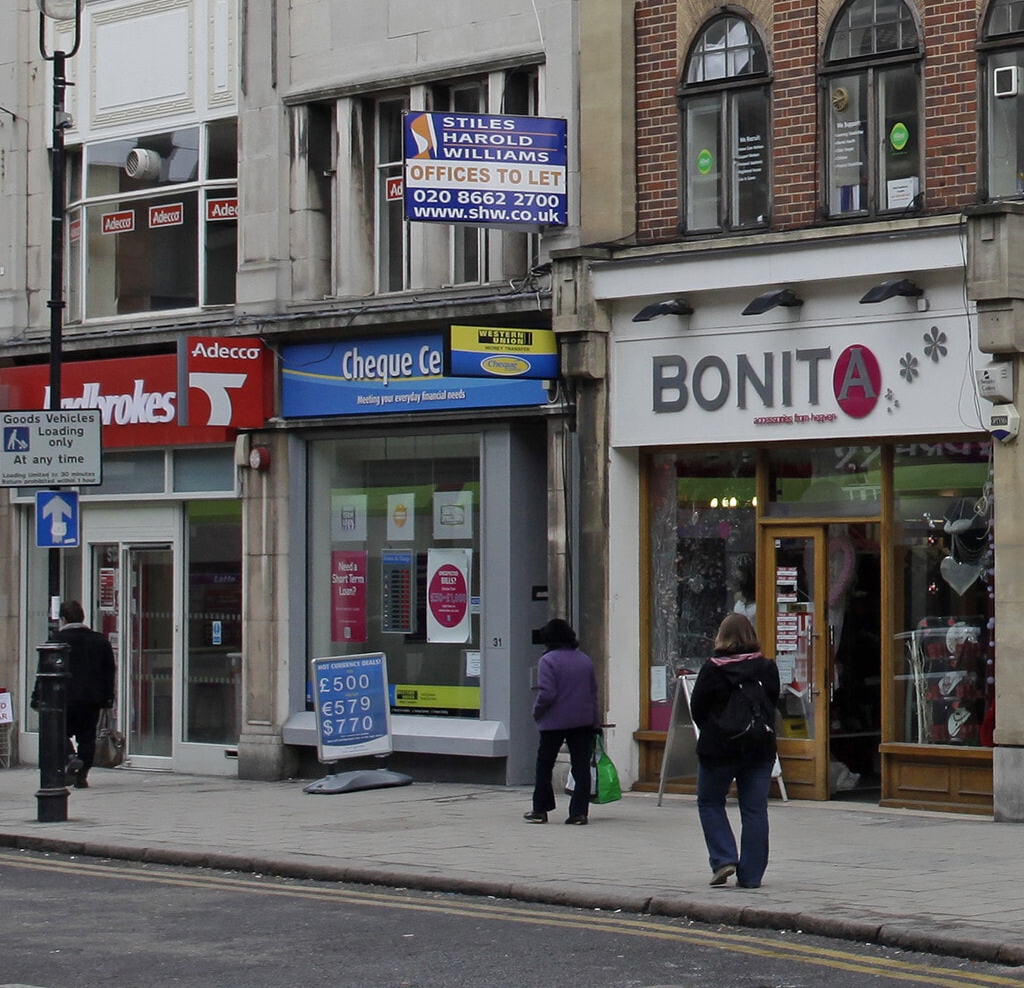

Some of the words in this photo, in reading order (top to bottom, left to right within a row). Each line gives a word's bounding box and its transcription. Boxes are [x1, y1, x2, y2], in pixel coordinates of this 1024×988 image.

[443, 117, 515, 130] STILES
[443, 132, 533, 146] HAROLD
[443, 148, 549, 163] WILLIAMS
[410, 165, 490, 183] OFFICES
[497, 168, 522, 184] TO
[528, 170, 562, 186] LET
[413, 190, 451, 203] 020
[458, 192, 506, 205] 8662
[514, 193, 559, 208] 2700
[153, 210, 180, 224] Adecco
[414, 206, 560, 222] www.shw.co.uk
[105, 217, 131, 231] Adecco
[480, 330, 524, 338] WESTERN
[192, 343, 260, 359] Adecco
[342, 347, 412, 386] Cheque
[652, 346, 877, 413] BONITA
[357, 395, 380, 406] Meeting
[381, 396, 394, 405] your
[395, 392, 420, 404] everyday
[422, 390, 446, 401] financial
[447, 389, 465, 399] needs
[3, 414, 40, 424] Goods
[46, 414, 95, 423] Vehicles
[38, 426, 84, 437] Loading
[49, 437, 73, 448] only
[14, 455, 27, 465] At
[33, 456, 53, 466] any
[58, 454, 84, 464] time
[338, 562, 353, 571] Need
[332, 573, 348, 584] Short
[349, 572, 364, 583] Term
[339, 587, 356, 596] Loan?
[493, 637, 502, 647] 31
